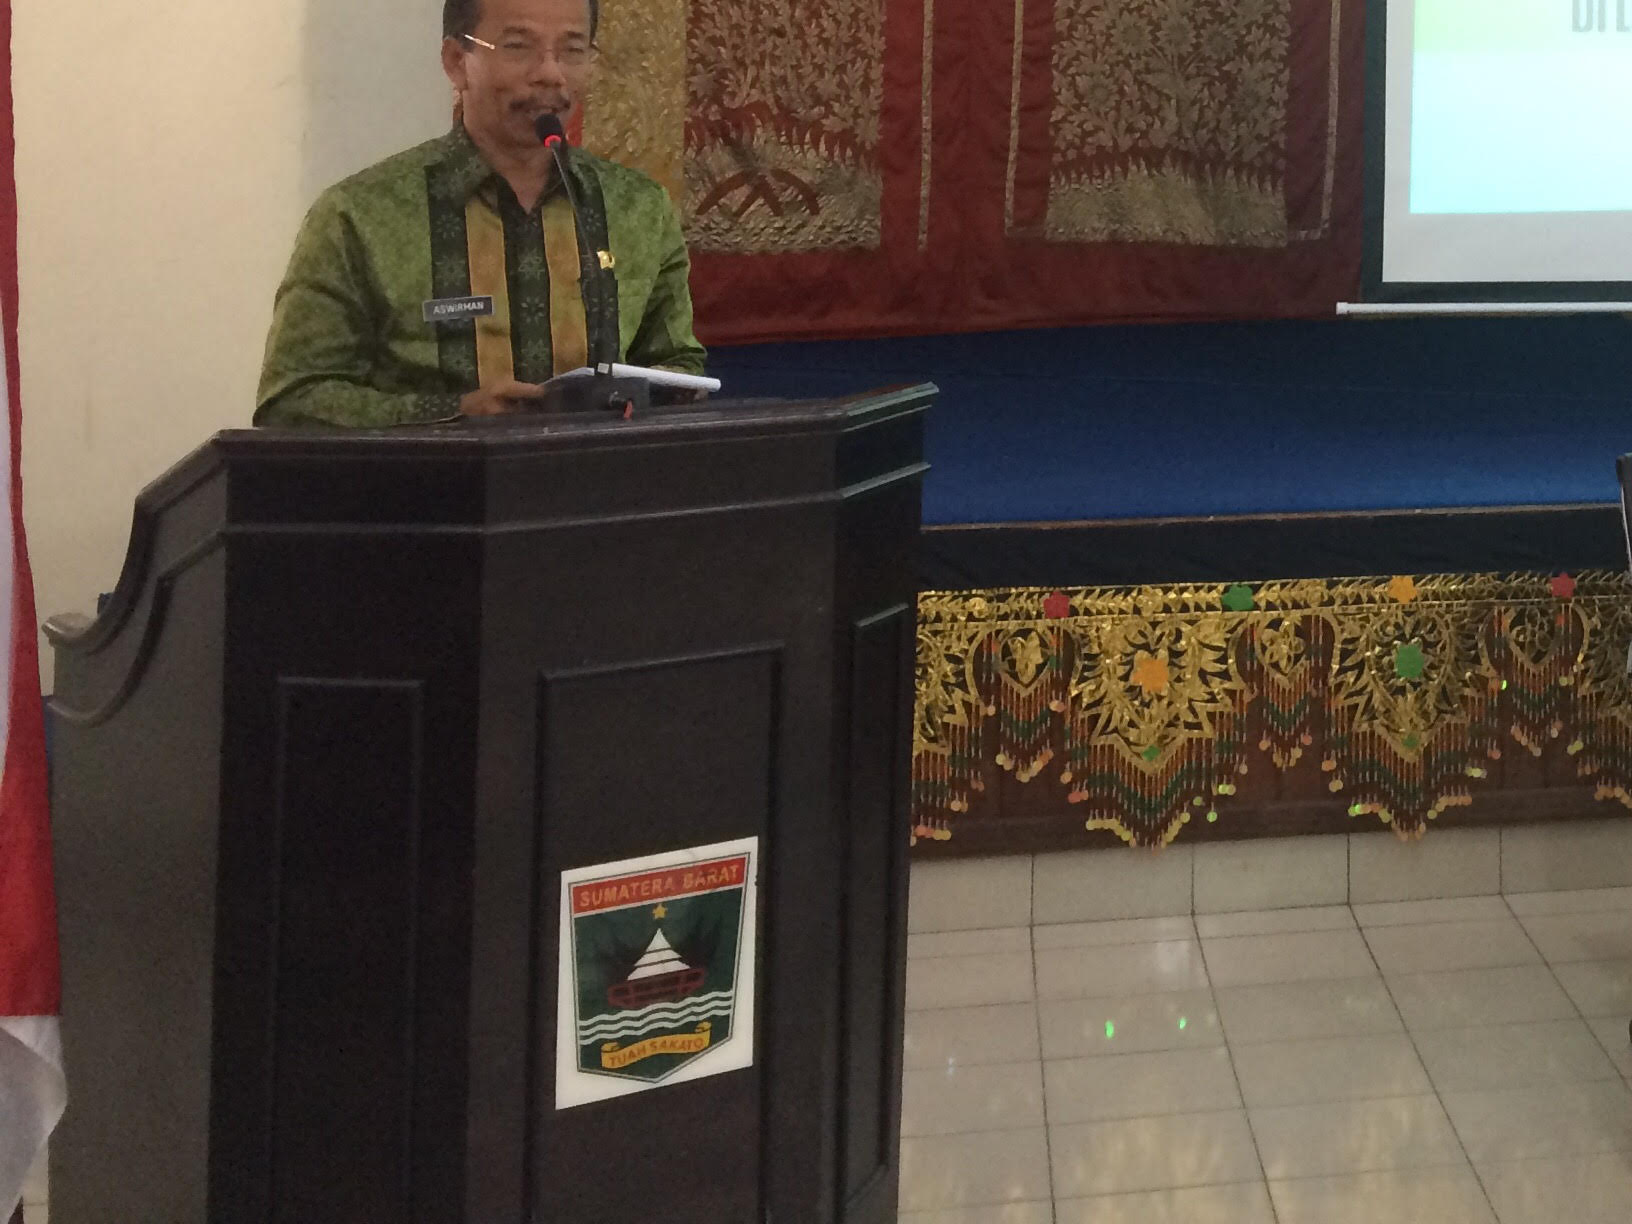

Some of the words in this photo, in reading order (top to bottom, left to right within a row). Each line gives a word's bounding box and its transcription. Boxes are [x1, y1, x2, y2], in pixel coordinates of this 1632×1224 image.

[433, 301, 484, 315] ASWIRMAN
[579, 877, 675, 907] SUMATERA
[682, 864, 739, 889] BARAT
[608, 1044, 648, 1067] TUAH
[650, 1036, 705, 1054] SAKATO
